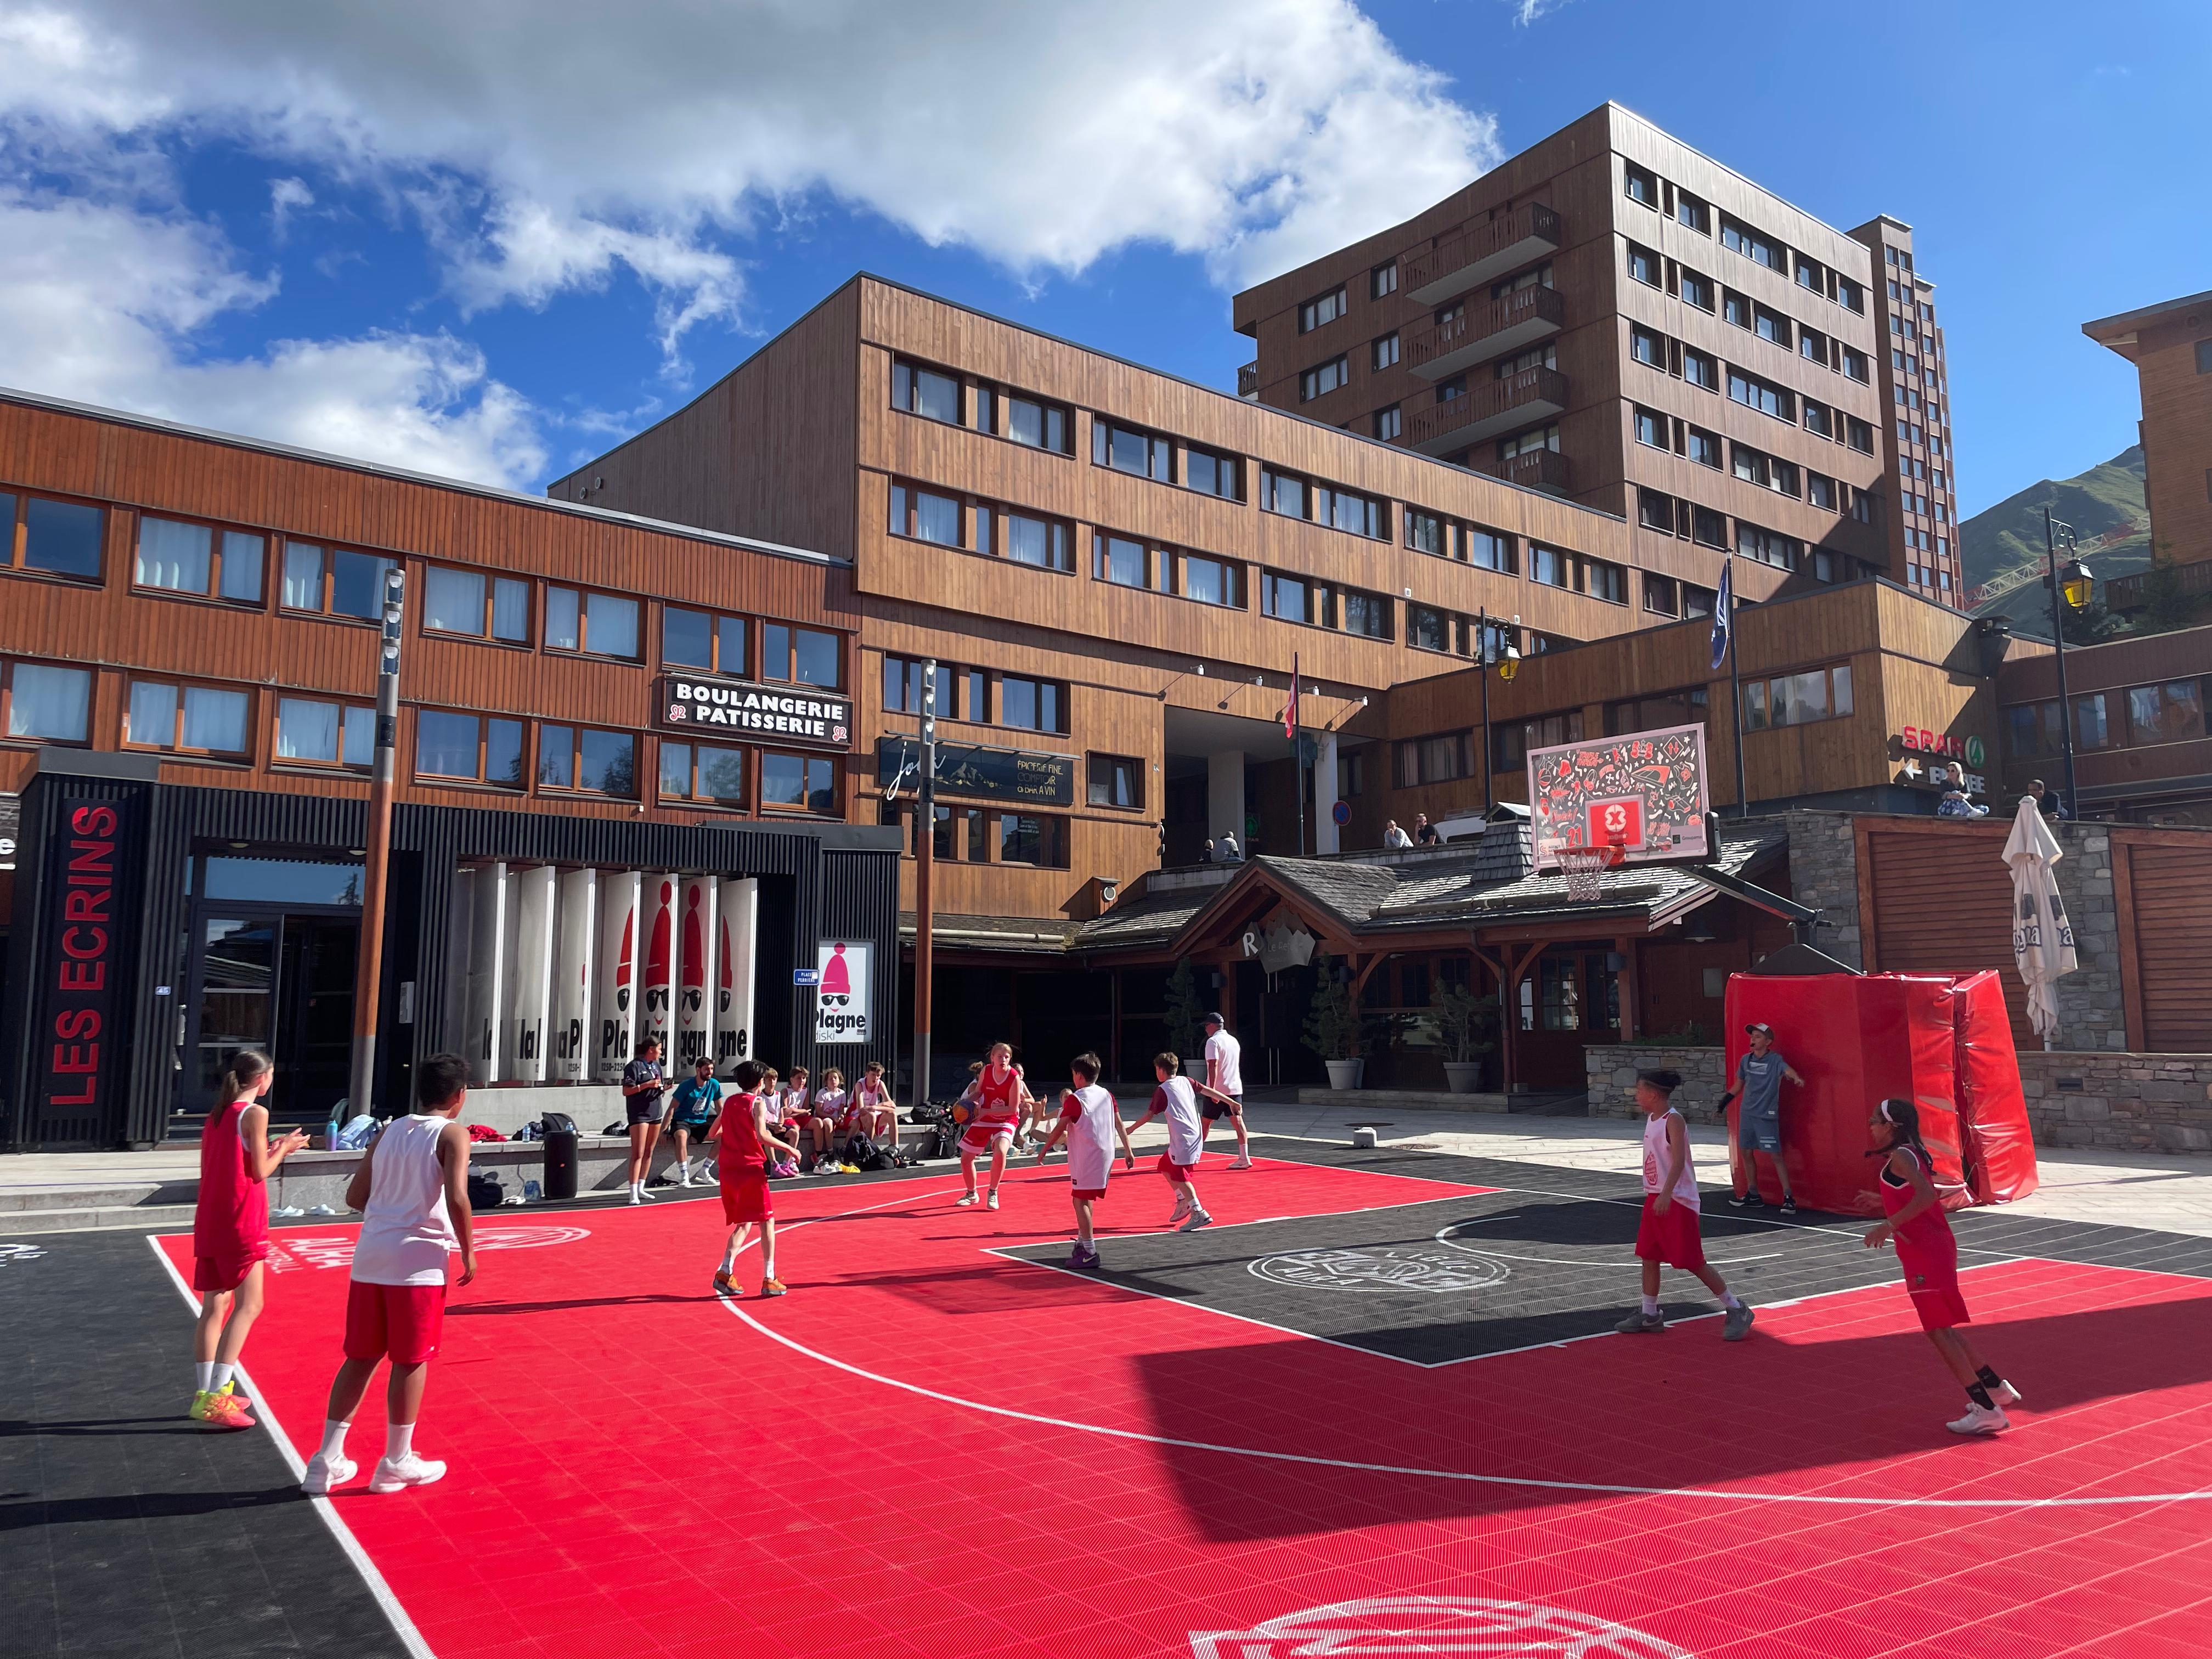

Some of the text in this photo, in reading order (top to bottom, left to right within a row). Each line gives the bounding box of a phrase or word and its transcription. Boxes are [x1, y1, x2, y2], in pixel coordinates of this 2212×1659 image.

[676, 683, 843, 720] BOULANGERIE
[696, 705, 825, 736] PATISSERIE
[1902, 725, 1964, 759] SPAR
[1018, 772, 1056, 785] COMPTOIR
[1048, 764, 1063, 775] FINE
[1045, 786, 1055, 795] VIN
[50, 806, 118, 1105] LES ECRINS
[1385, 1251, 1481, 1269] LIGUE
[1274, 1267, 1365, 1285] AURA
